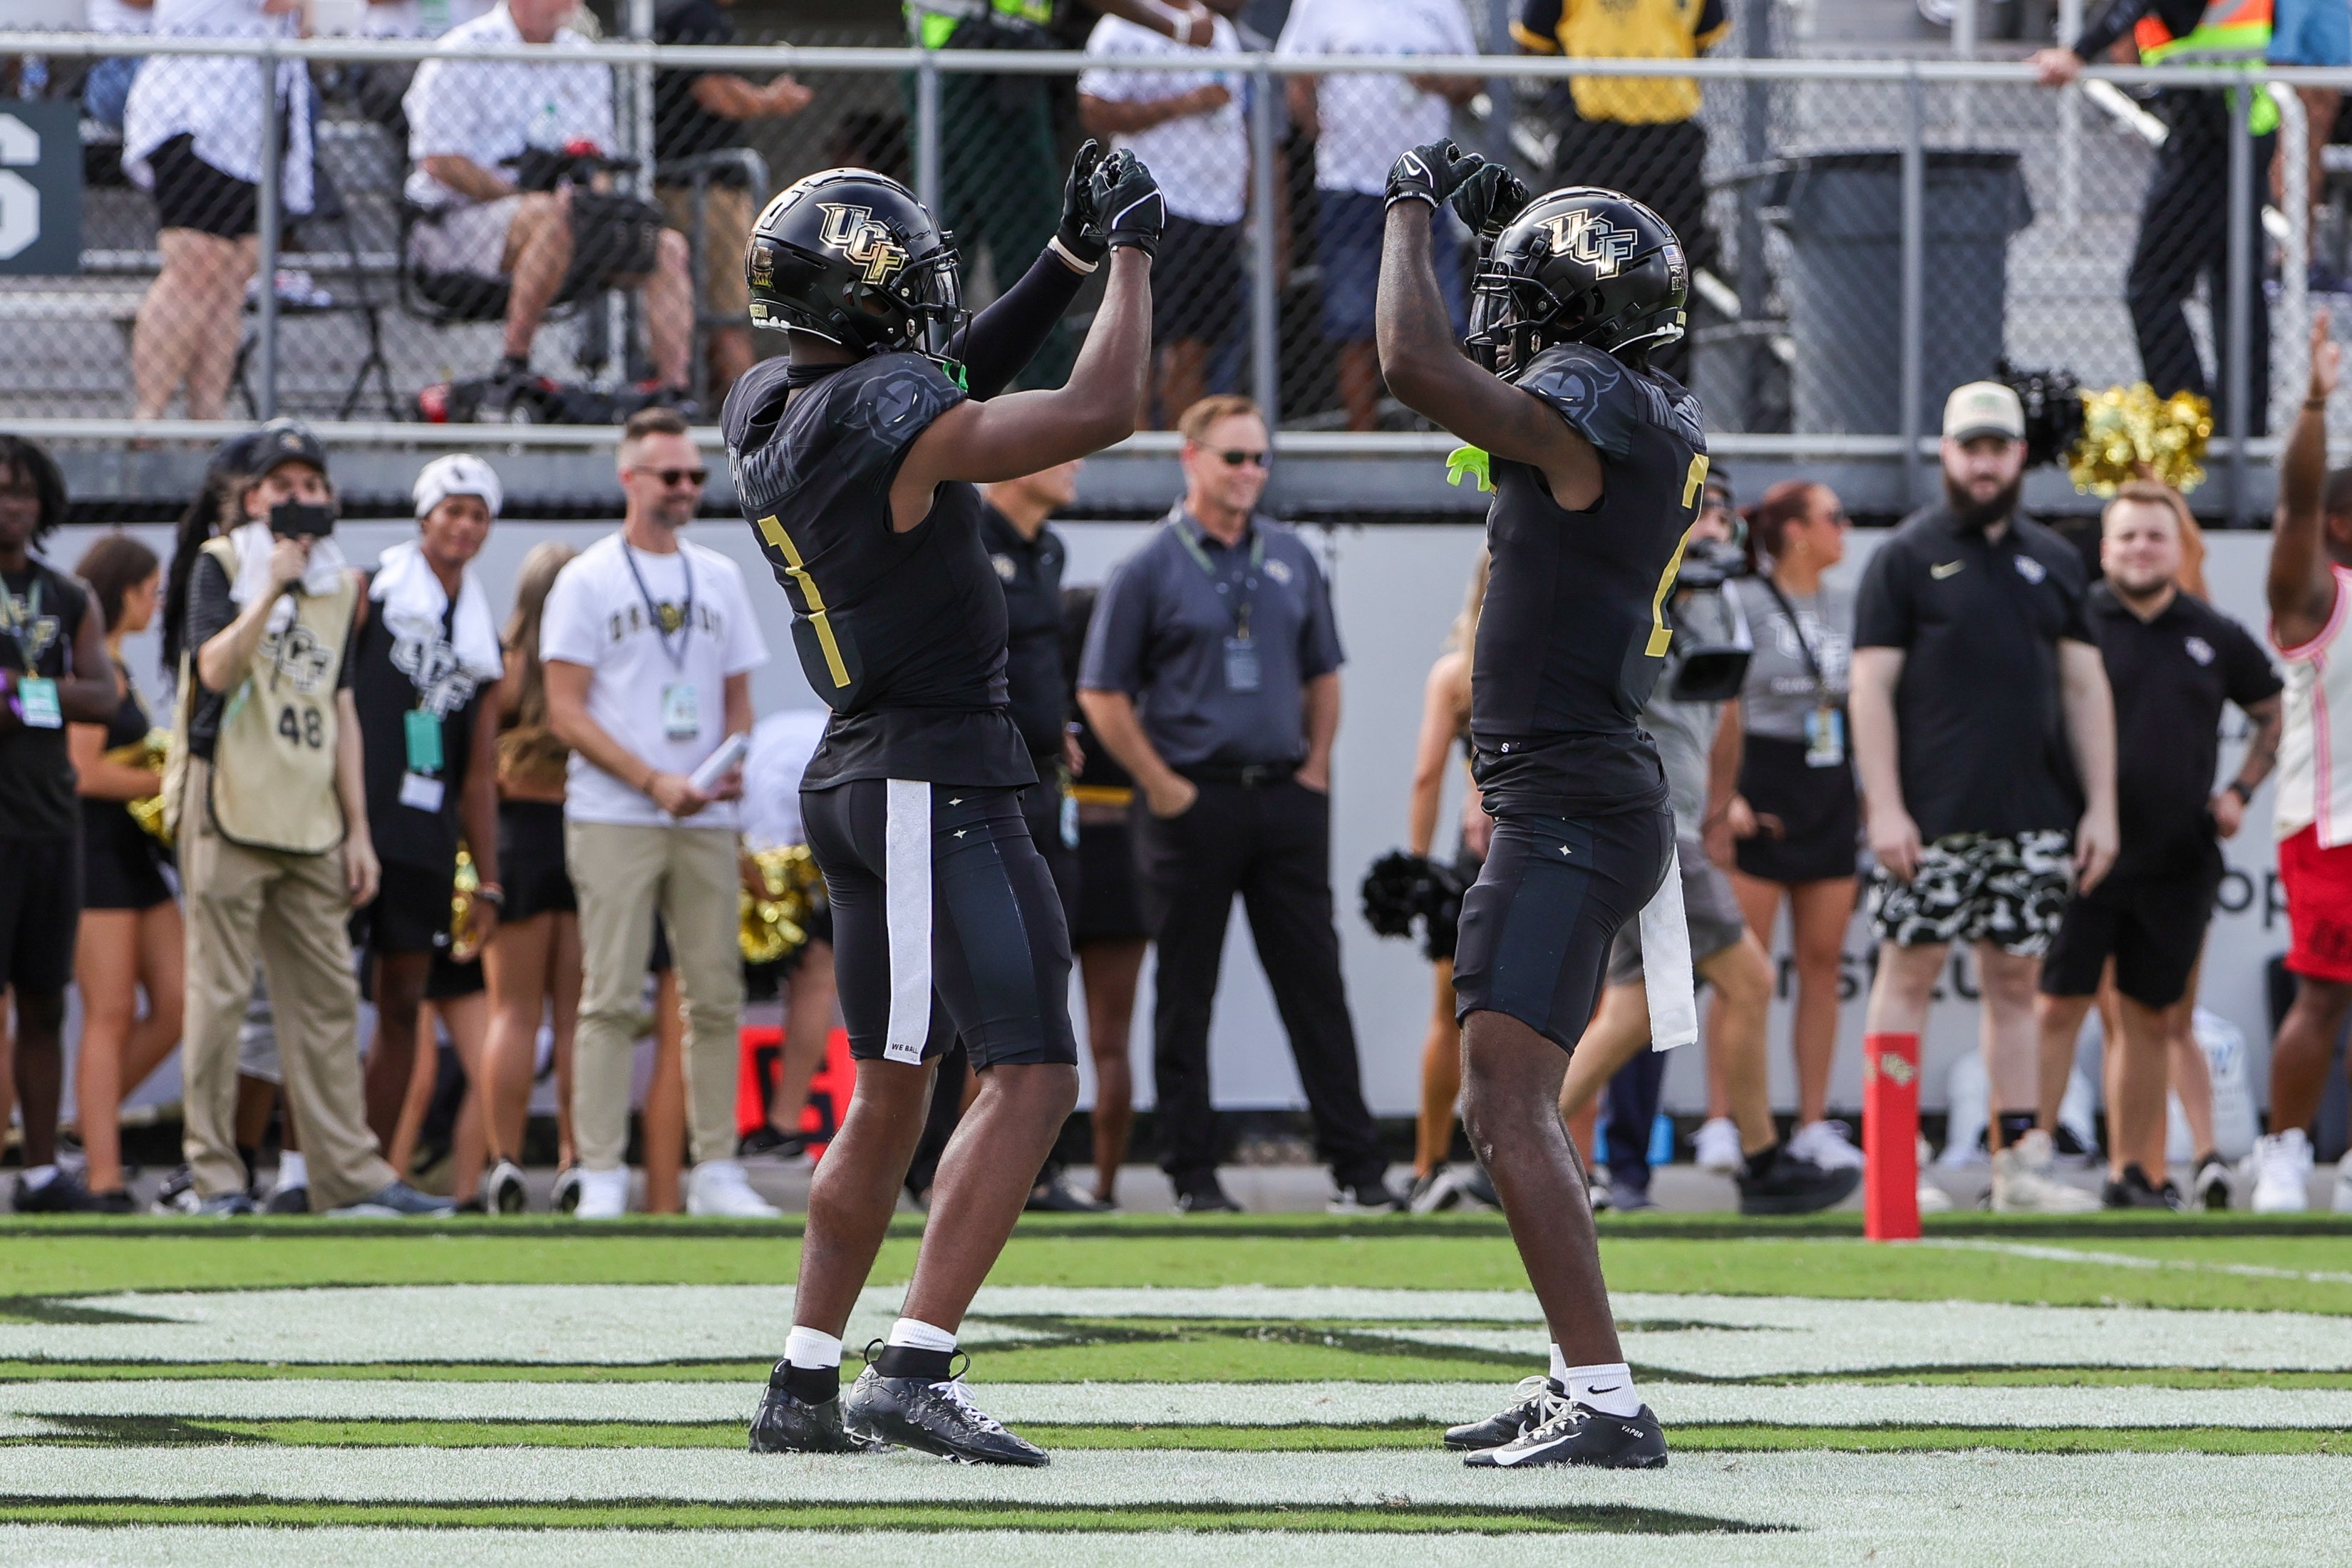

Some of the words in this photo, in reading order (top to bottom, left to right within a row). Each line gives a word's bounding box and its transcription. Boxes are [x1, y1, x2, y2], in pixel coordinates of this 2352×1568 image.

[815, 202, 909, 285] UCF
[1533, 208, 1638, 281] UCF
[742, 435, 802, 506] BAKER
[1644, 453, 1710, 658] 2
[757, 514, 852, 688] 1
[279, 703, 324, 750] 48
[892, 1043, 904, 1051] WE
[904, 1045, 919, 1054] BALL
[1621, 1424, 1644, 1439] VAPOR
